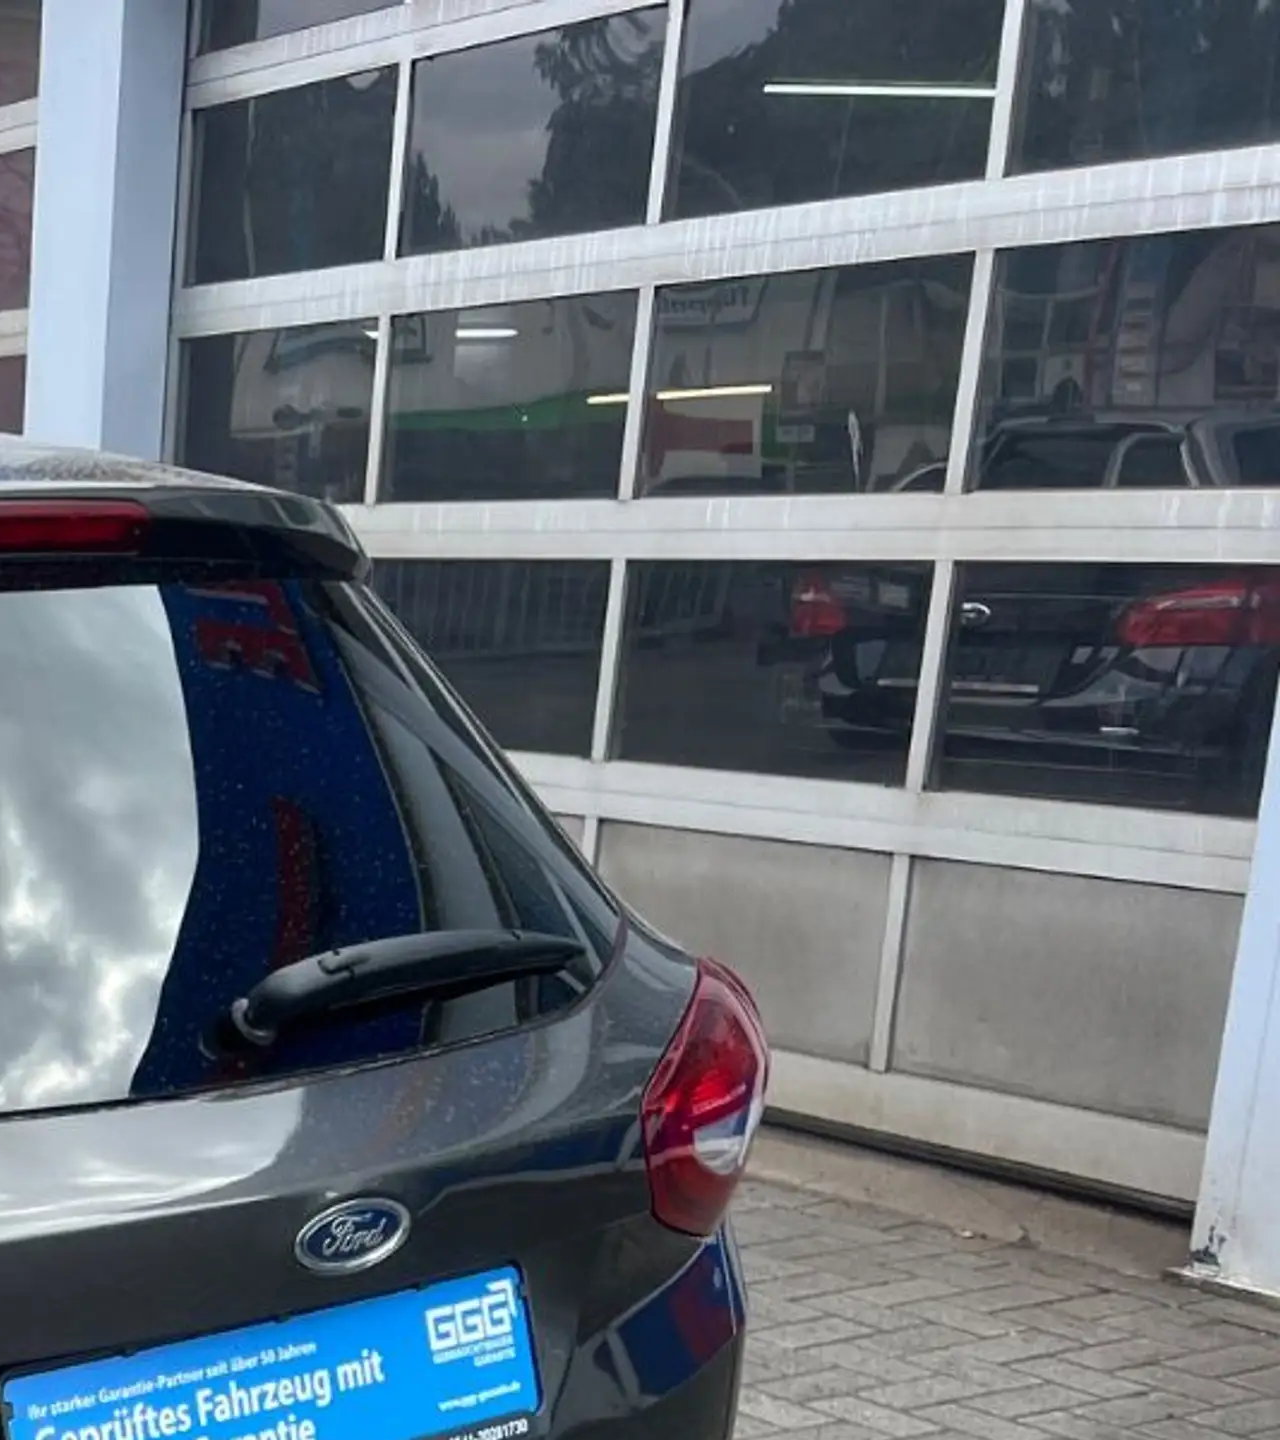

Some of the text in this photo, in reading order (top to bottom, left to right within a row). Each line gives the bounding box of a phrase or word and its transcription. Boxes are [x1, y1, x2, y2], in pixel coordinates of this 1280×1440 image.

[323, 1212, 387, 1255] Ford
[425, 1279, 517, 1351] GGG
[27, 1342, 317, 1421] Ihr starker Garantie-Partner seit über 50 Jahren
[196, 1367, 333, 1427] Fahrzeug
[337, 1348, 384, 1391] mit
